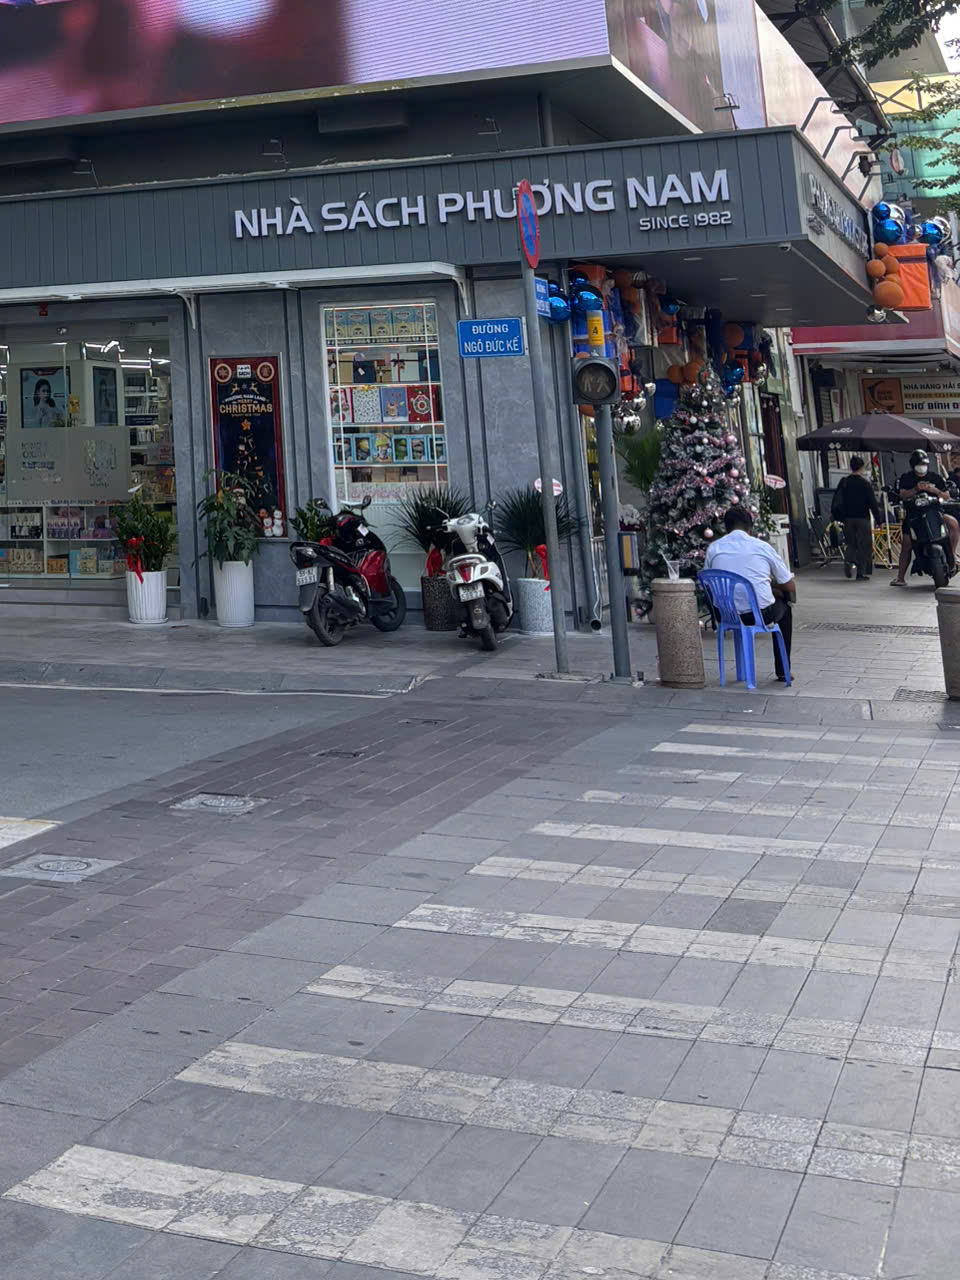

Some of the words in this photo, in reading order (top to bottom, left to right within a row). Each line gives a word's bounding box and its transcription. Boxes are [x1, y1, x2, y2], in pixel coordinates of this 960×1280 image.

[234, 197, 314, 239] NHÀ
[322, 191, 426, 233] SÁCH
[626, 169, 731, 209] NAM
[639, 214, 690, 231] SINCE
[693, 210, 732, 226] 1982
[472, 322, 509, 334] ĐƯỜNG
[464, 338, 484, 353] NGÔ
[485, 337, 505, 352] ĐỨC
[506, 335, 520, 351] KẾ
[219, 404, 273, 414] CHRISTMAS
